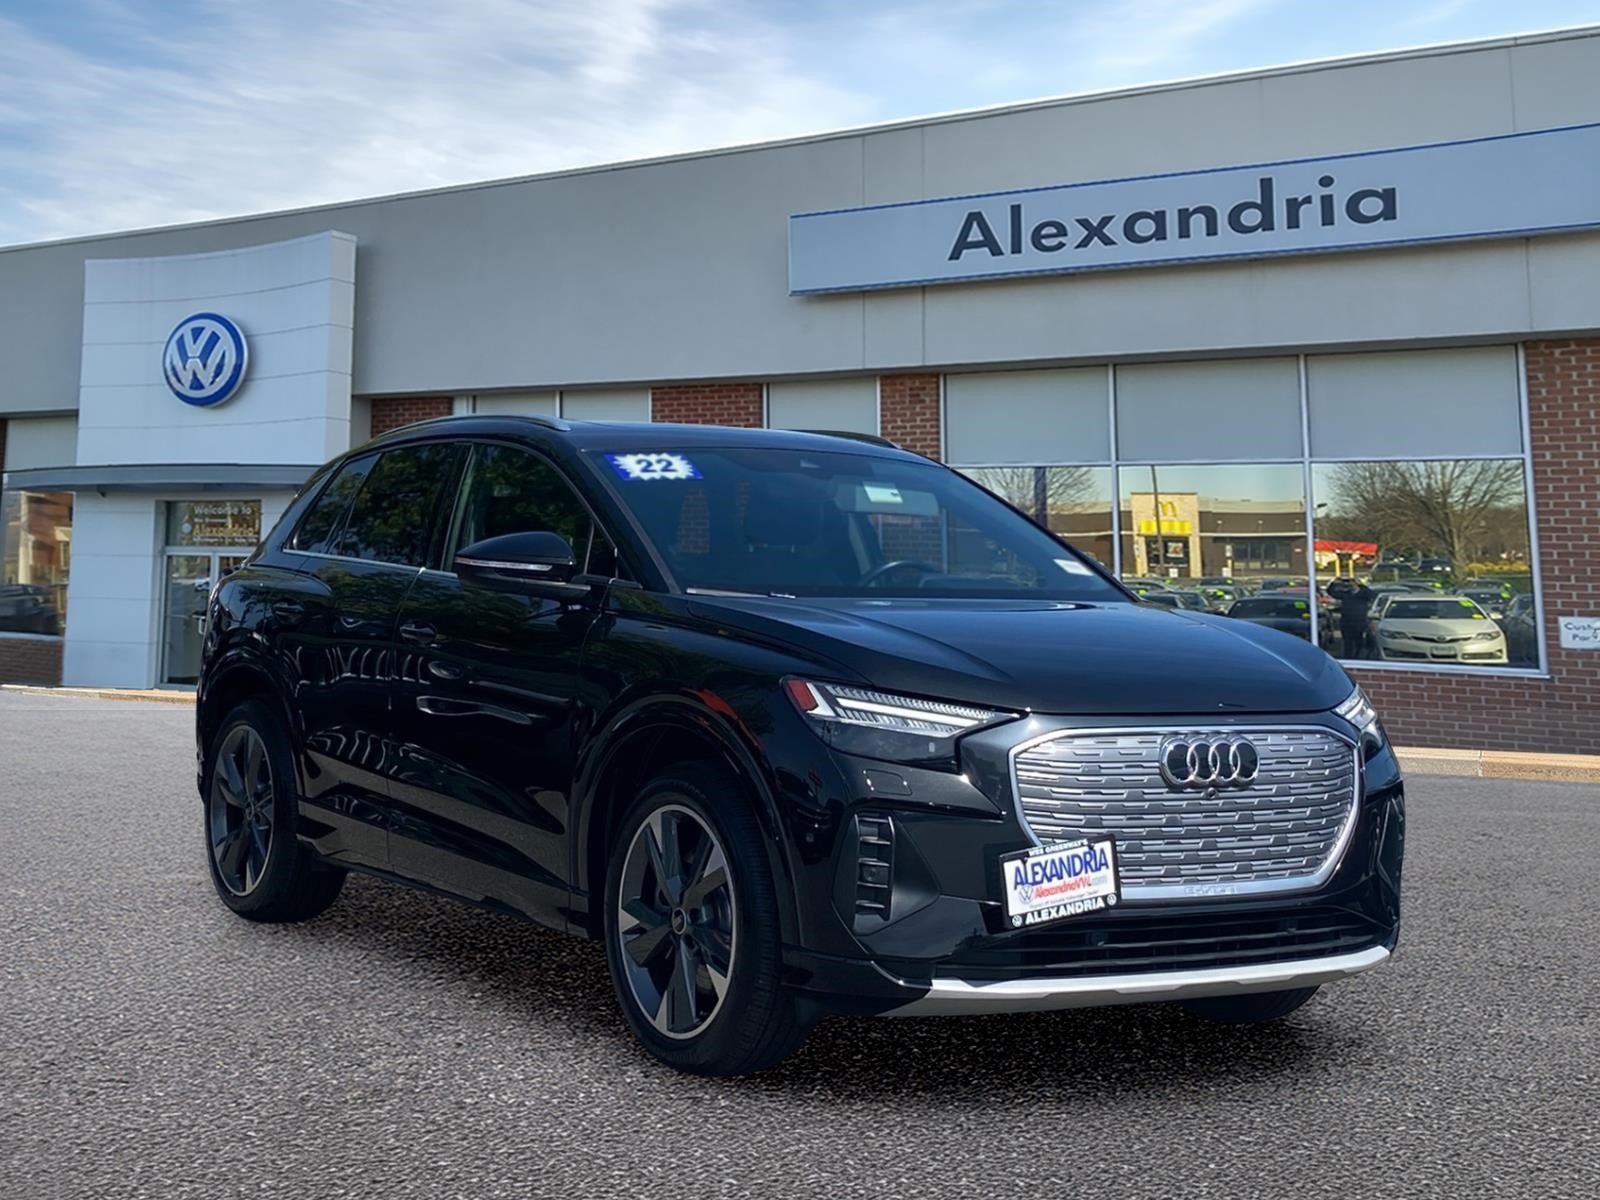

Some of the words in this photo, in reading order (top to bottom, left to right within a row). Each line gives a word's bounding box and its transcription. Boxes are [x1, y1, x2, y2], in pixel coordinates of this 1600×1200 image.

[947, 174, 1398, 262] Alexandria
[635, 458, 678, 473] 22
[1014, 847, 1109, 891] ALEXANDRIA
[1025, 897, 1105, 925] ALEXANDRIA
